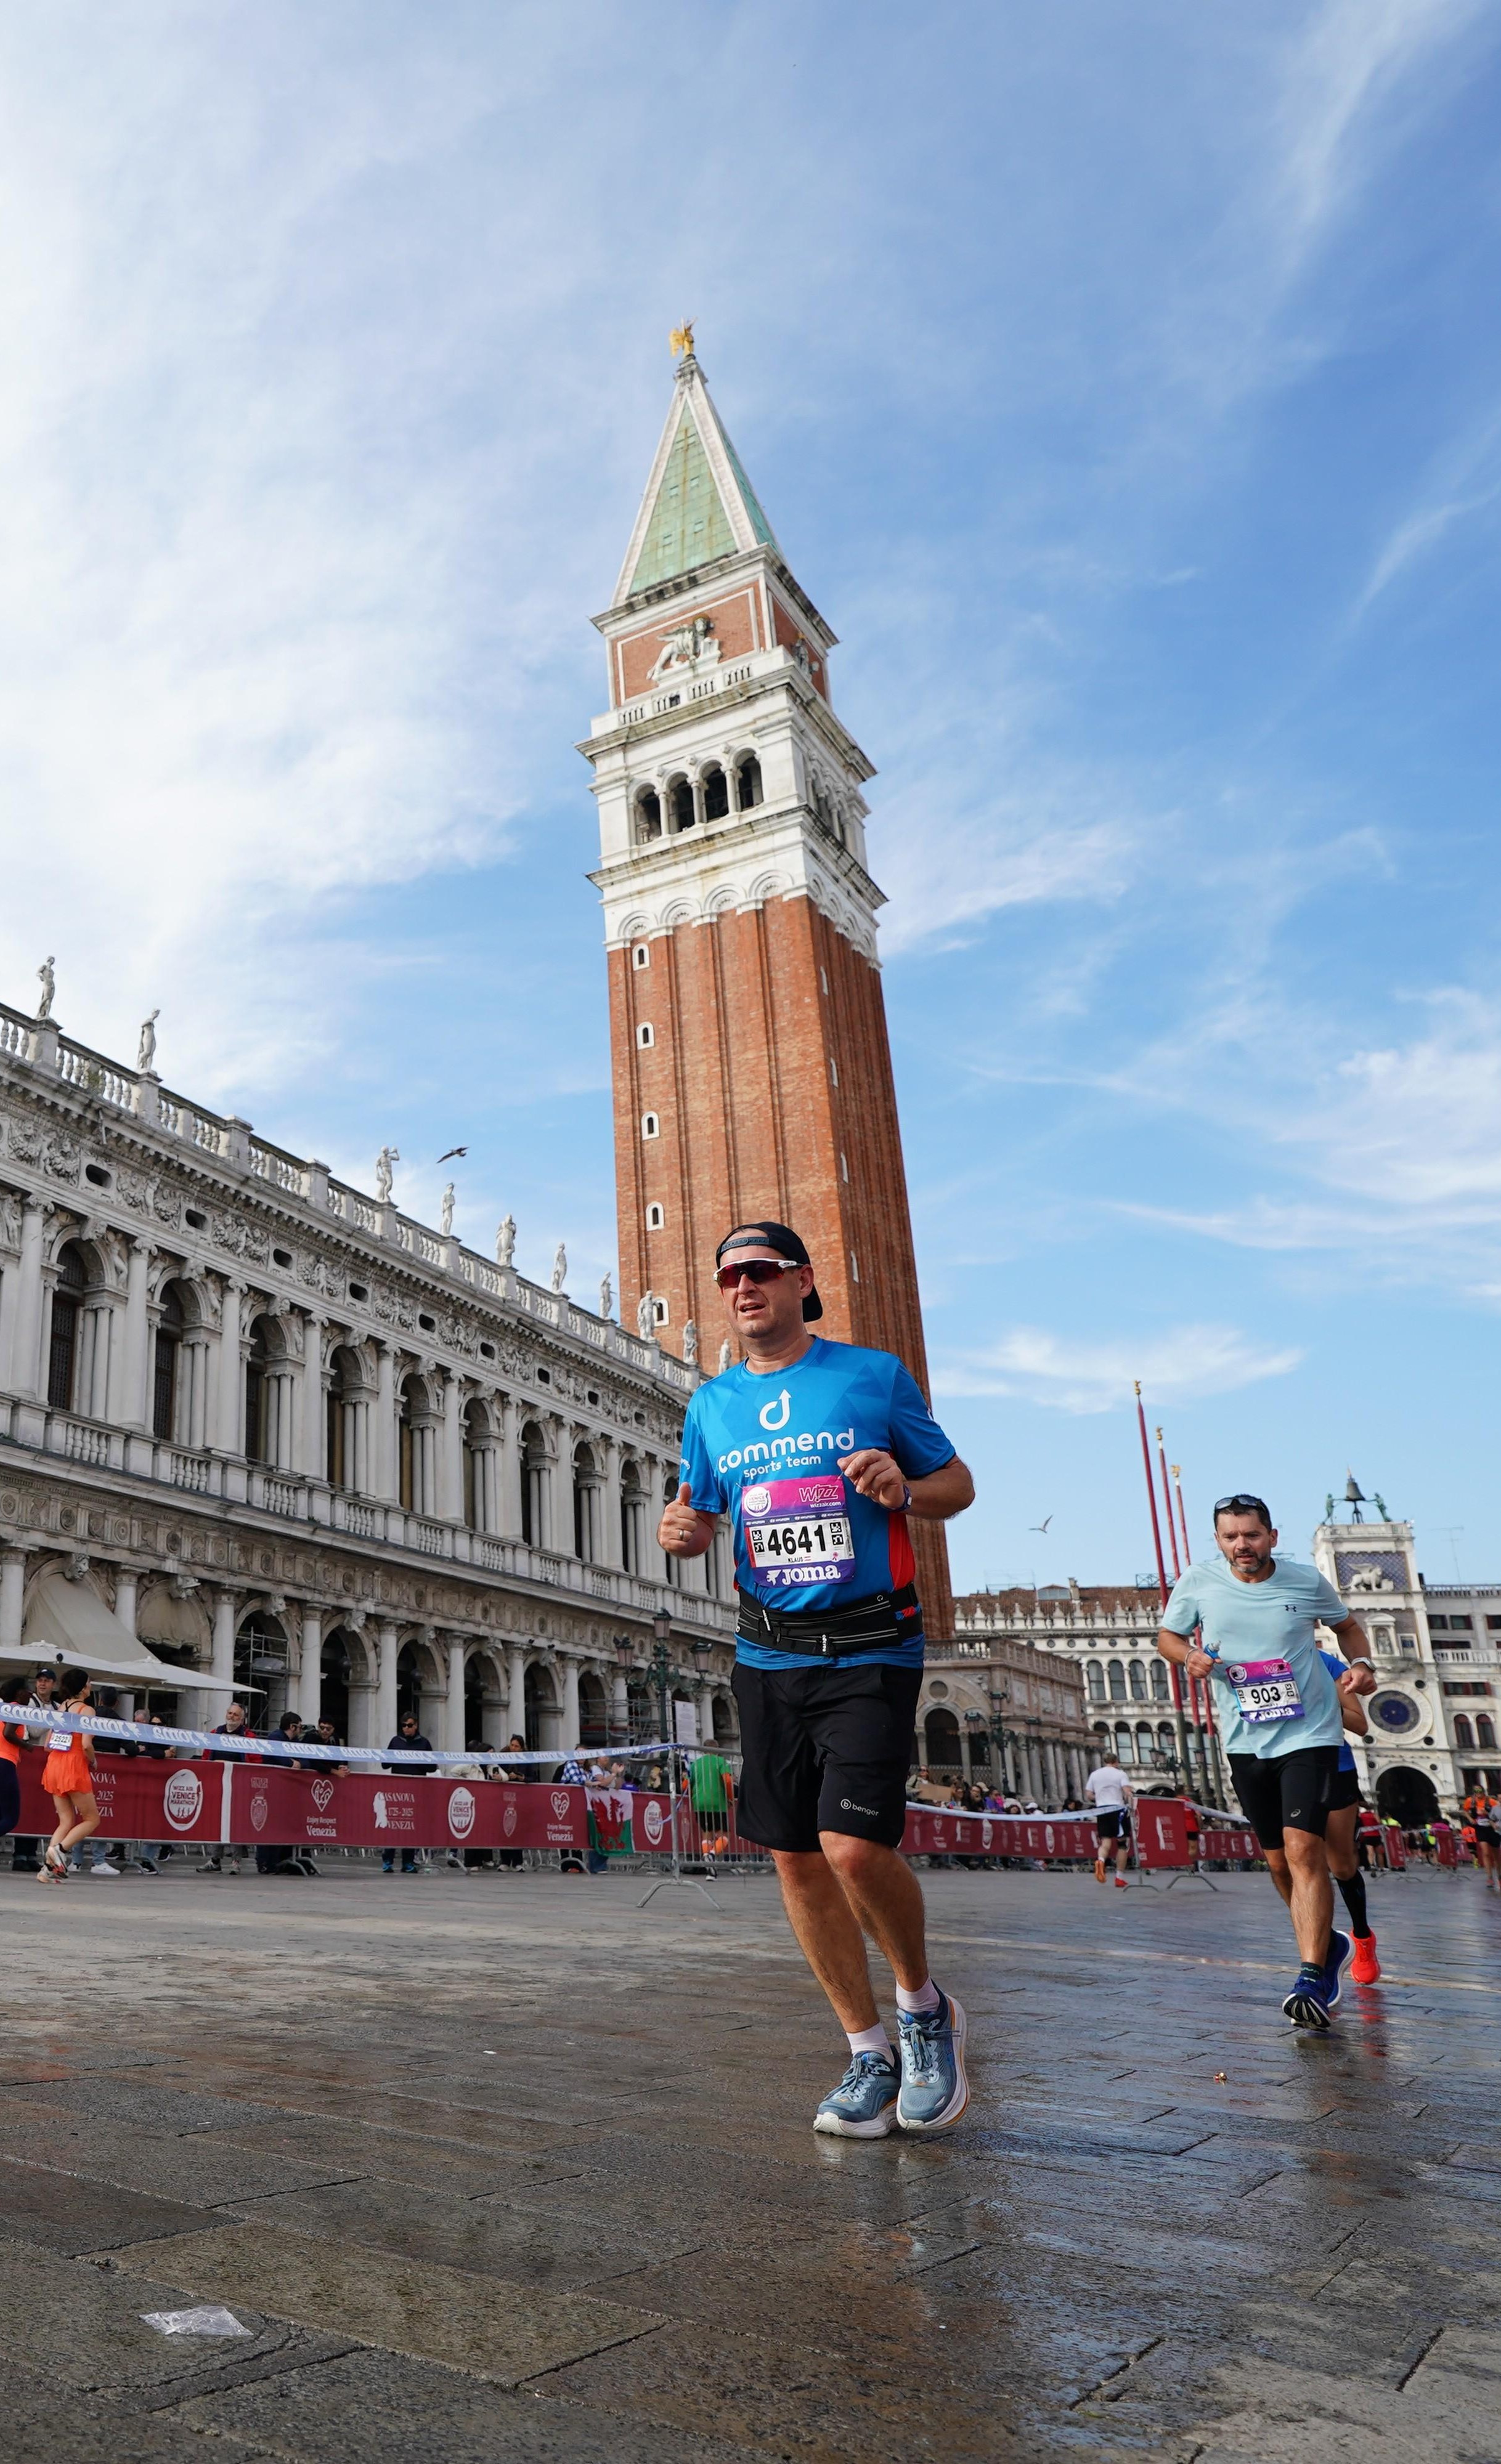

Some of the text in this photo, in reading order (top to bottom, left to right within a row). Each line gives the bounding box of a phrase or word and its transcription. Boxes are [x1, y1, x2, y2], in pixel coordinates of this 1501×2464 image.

[718, 1428, 855, 1473] commend
[743, 1456, 821, 1480] sports team
[768, 1525, 826, 1556] 4641
[1251, 1686, 1281, 1704] 903
[172, 1791, 196, 1800] VENICE
[852, 1803, 879, 1816] benger
[306, 1825, 337, 1837] Venezia
[546, 1831, 574, 1842] Venezia
